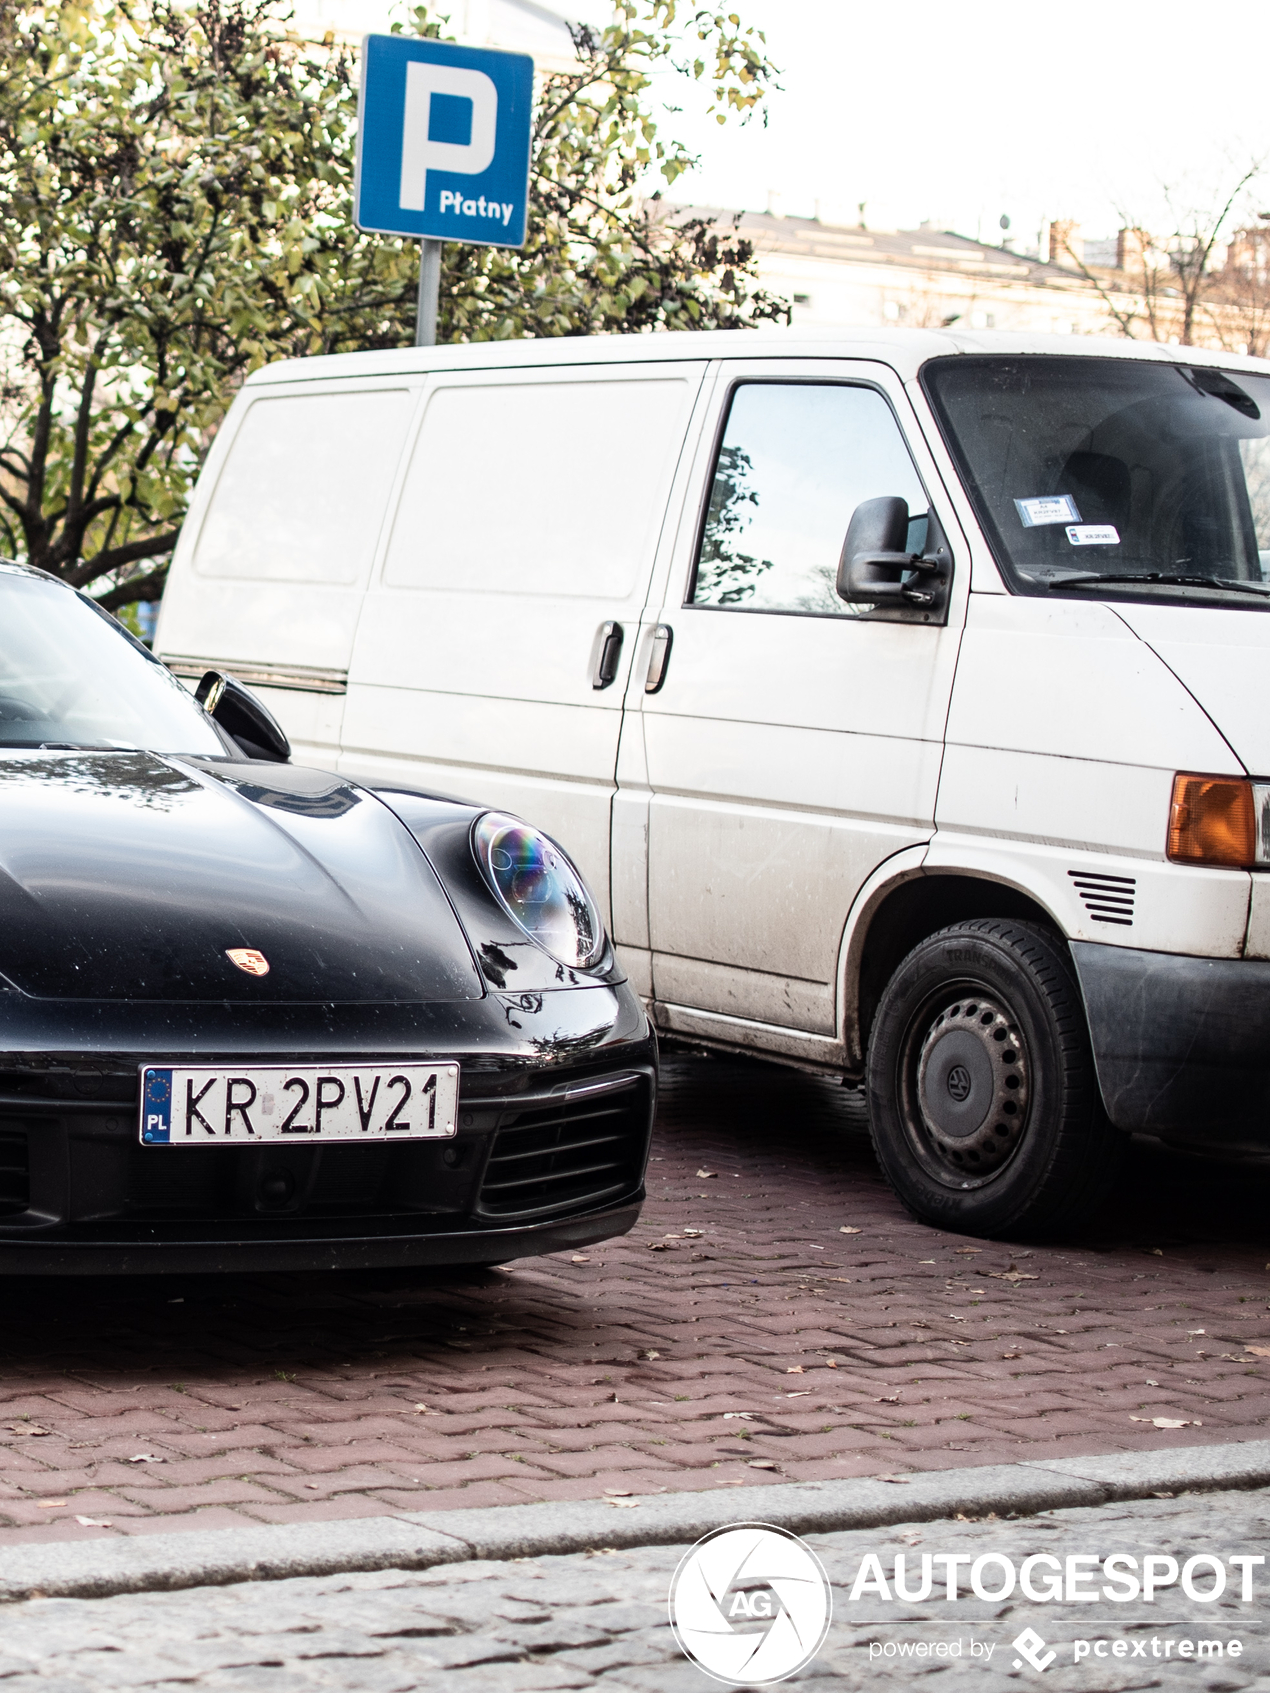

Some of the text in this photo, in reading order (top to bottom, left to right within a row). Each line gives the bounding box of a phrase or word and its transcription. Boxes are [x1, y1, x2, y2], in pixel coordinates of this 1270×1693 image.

[399, 60, 498, 211] P
[439, 190, 514, 226] Płatny
[147, 1114, 167, 1130] PL
[185, 1073, 438, 1135] KR 2PV21
